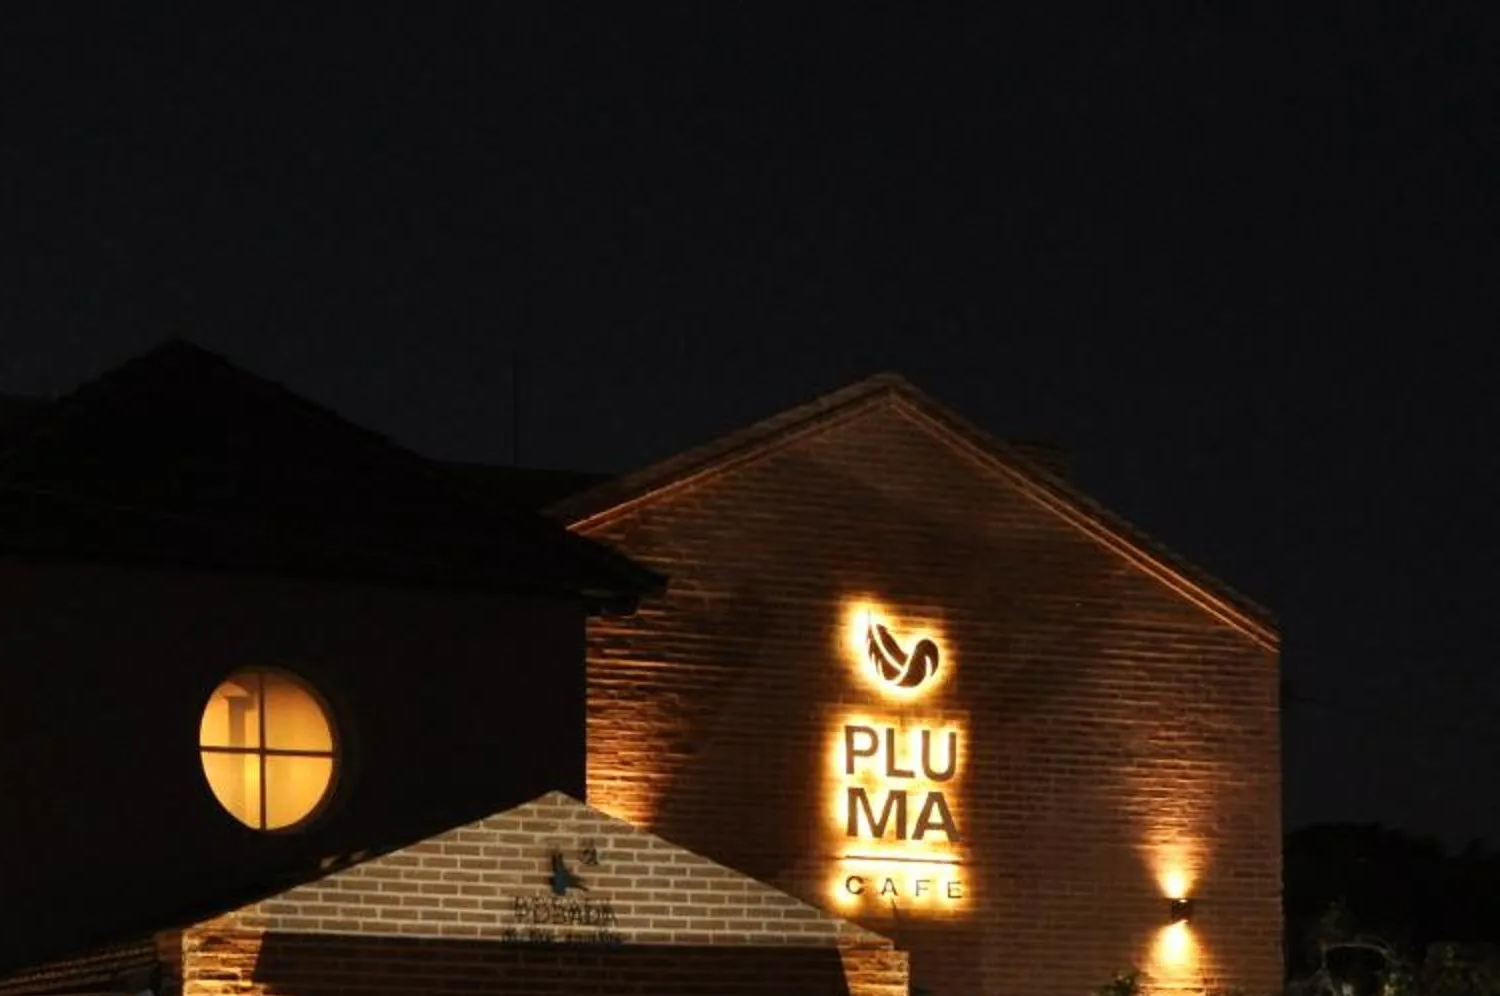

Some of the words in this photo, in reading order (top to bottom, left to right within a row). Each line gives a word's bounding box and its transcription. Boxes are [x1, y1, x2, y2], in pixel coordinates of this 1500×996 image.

[844, 725, 957, 782] PLU
[846, 787, 962, 842] MA
[845, 875, 962, 899] CAFE
